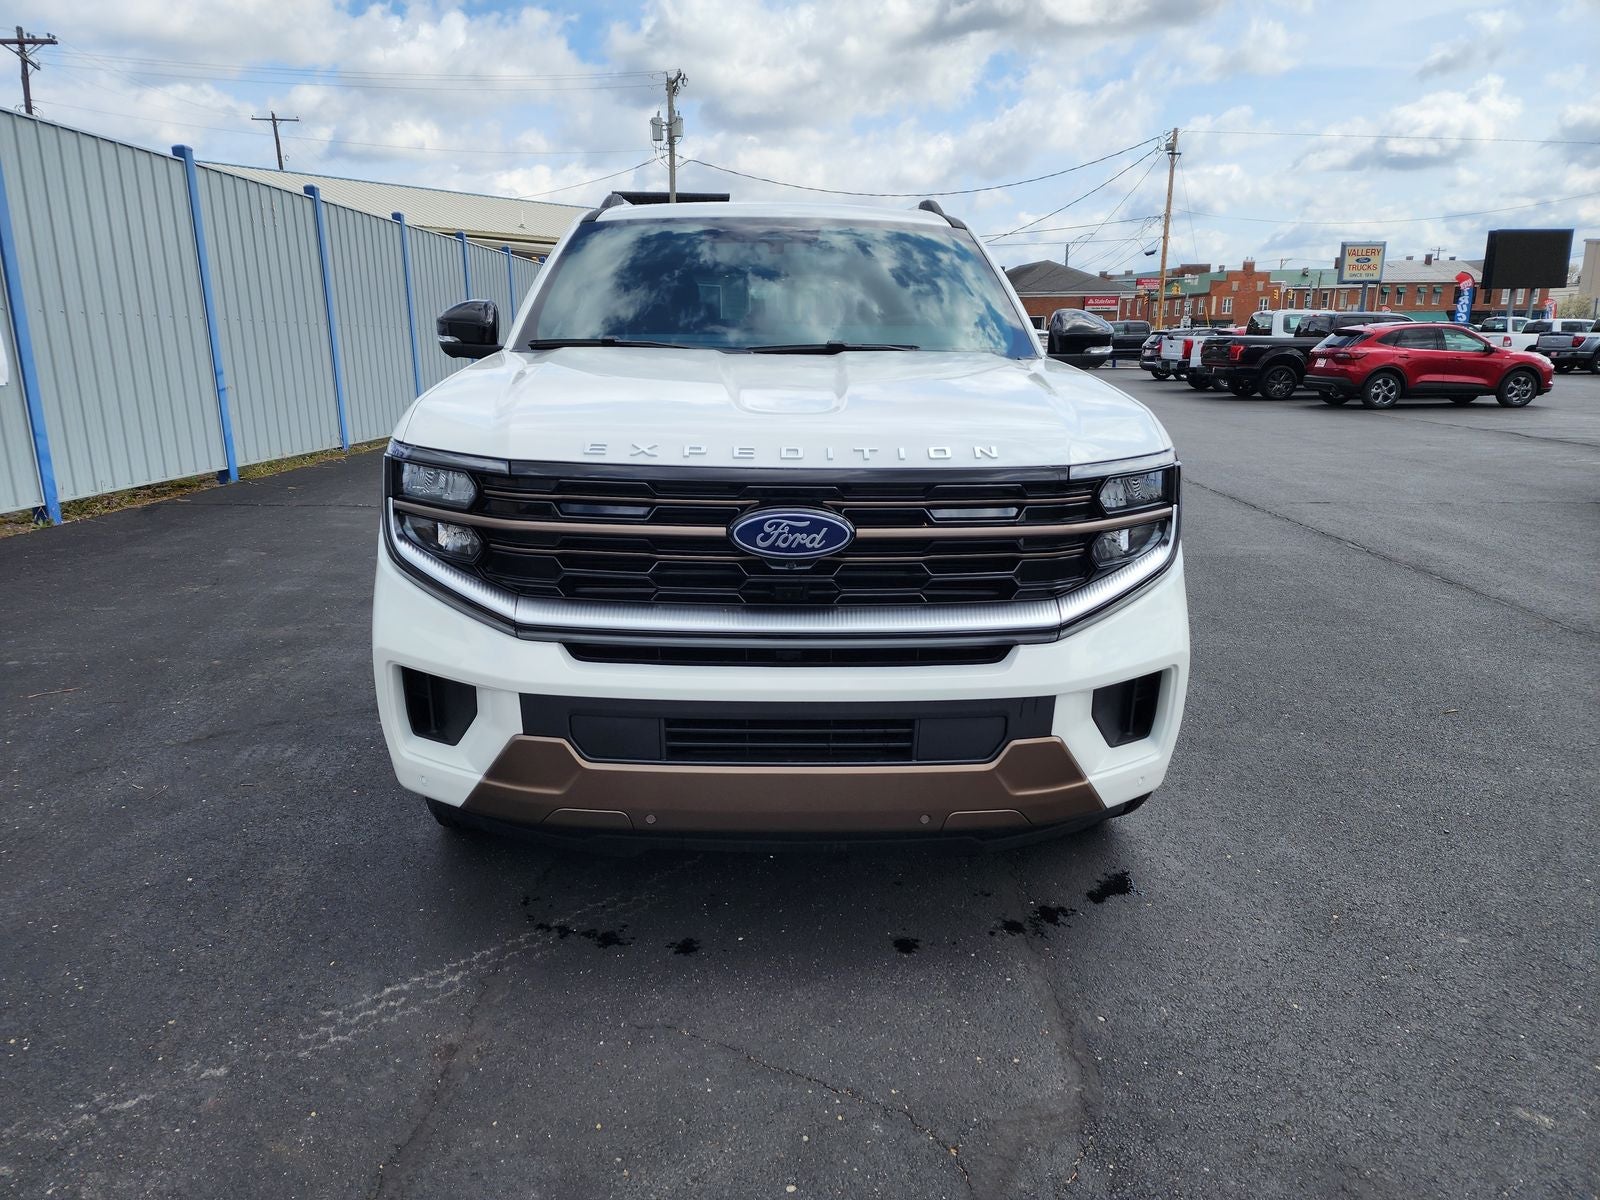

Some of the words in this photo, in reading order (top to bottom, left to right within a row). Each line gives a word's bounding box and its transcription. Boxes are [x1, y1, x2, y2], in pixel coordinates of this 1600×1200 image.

[1347, 248, 1381, 257] VALLERY
[582, 440, 1000, 461] EXPEDITION
[755, 517, 828, 550] Ford
